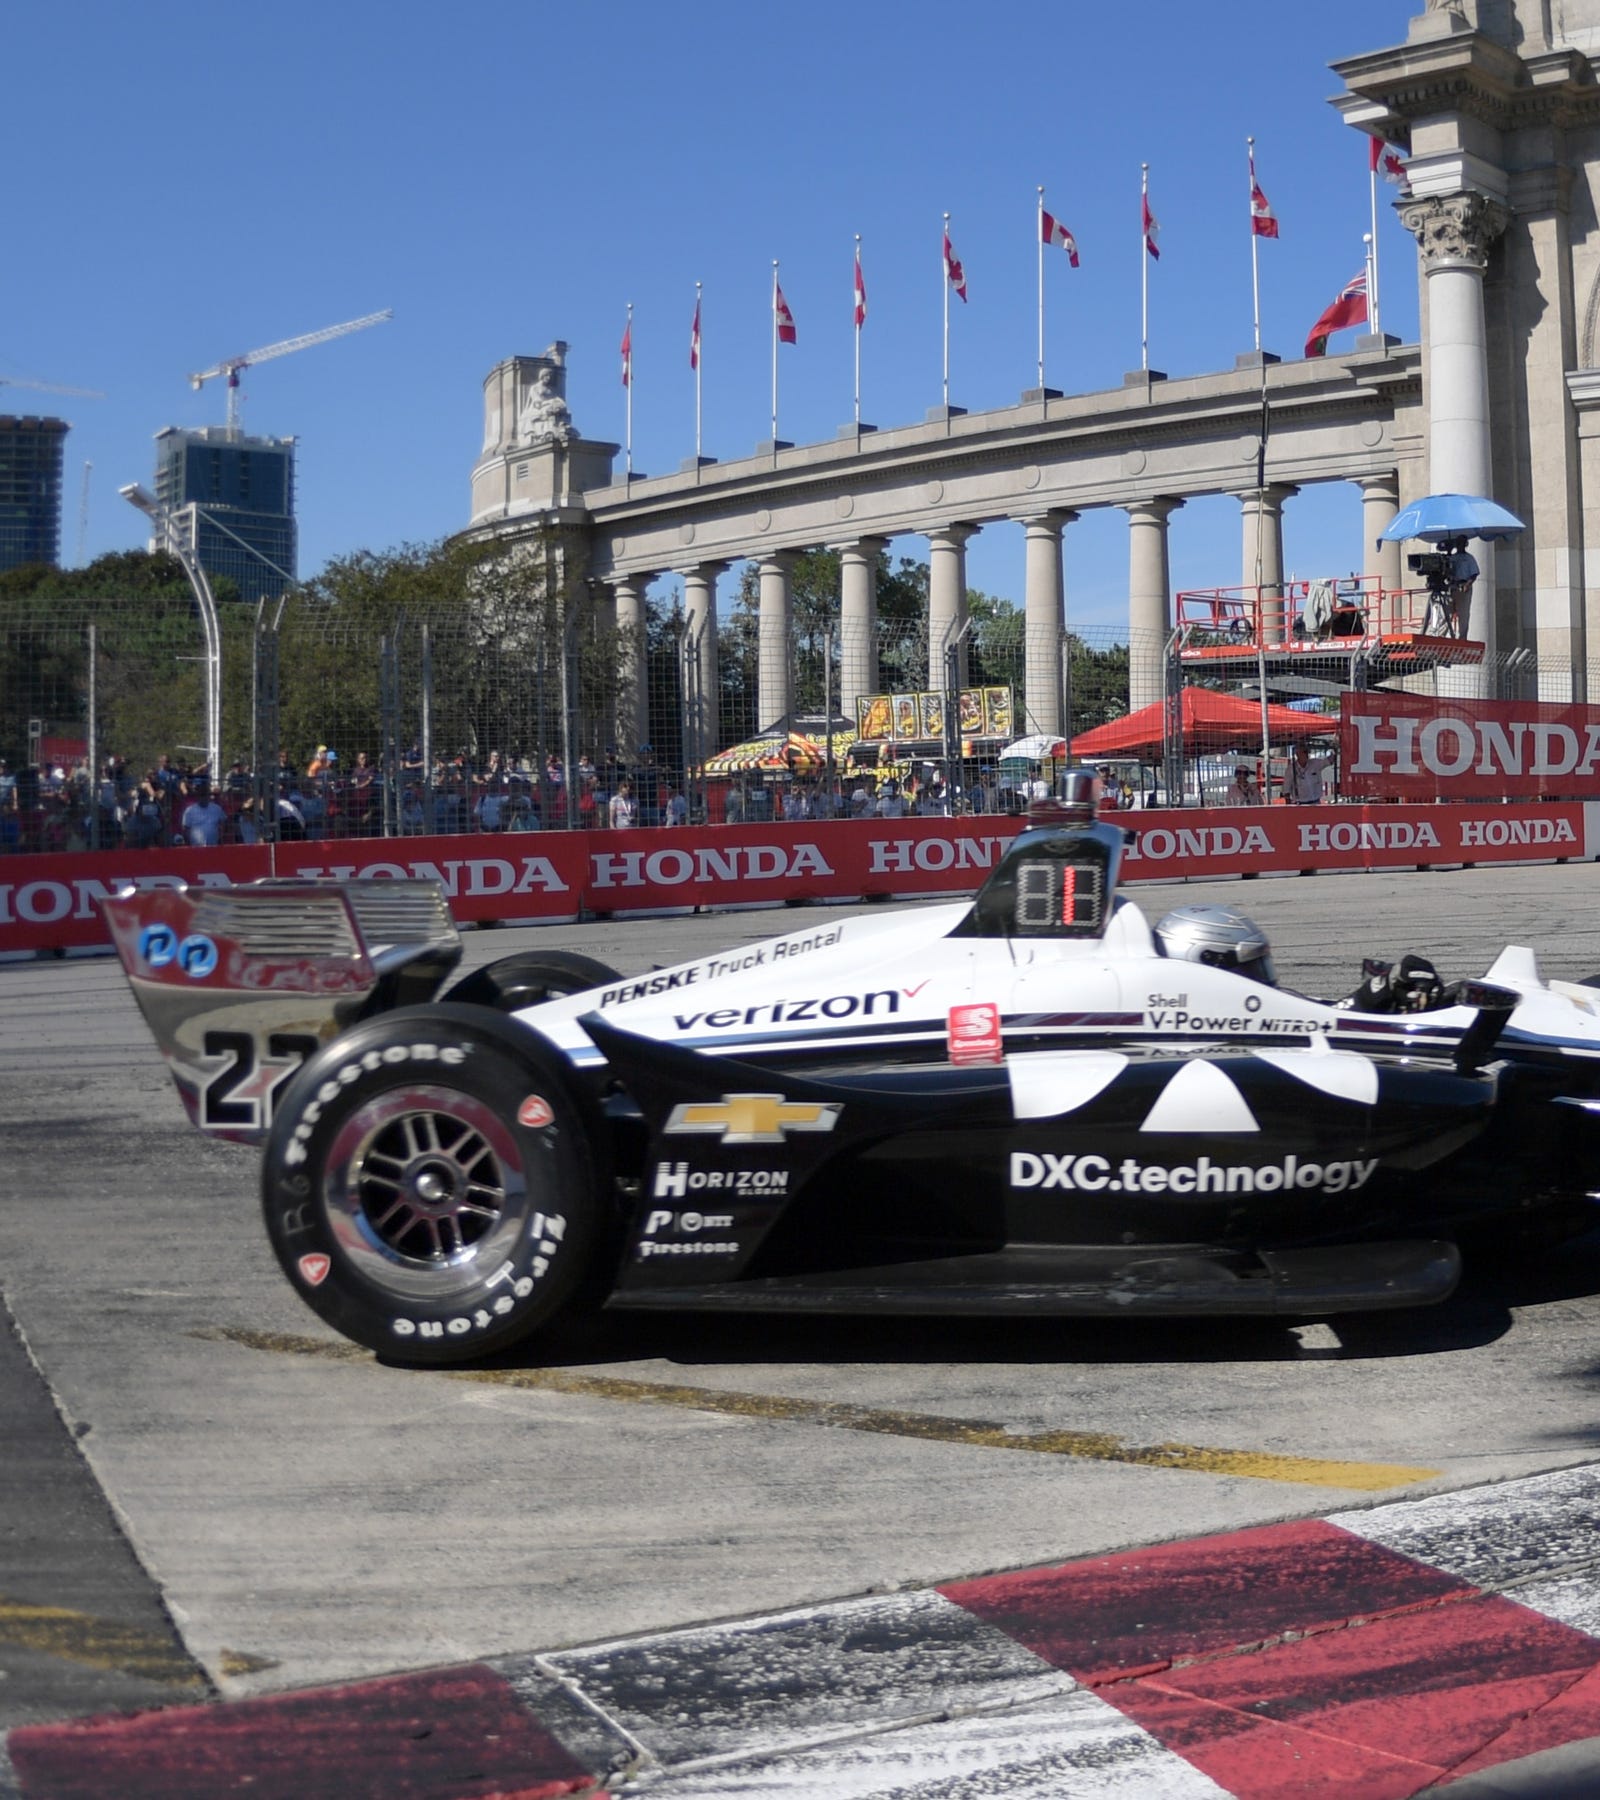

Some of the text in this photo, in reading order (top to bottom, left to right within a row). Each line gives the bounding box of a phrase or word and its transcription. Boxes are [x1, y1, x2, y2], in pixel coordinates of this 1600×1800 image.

[1298, 822, 1441, 852] HONDA
[1459, 818, 1577, 847] HONDA
[591, 843, 836, 889] HONDA
[868, 835, 1018, 874] HON
[600, 925, 845, 1009] PENSKE Truck Rental
[673, 988, 900, 1031] verizon
[1147, 994, 1188, 1008] Shell
[1149, 1011, 1254, 1031] V-Power
[653, 1161, 790, 1198] HORIZON
[1009, 1151, 1380, 1194] DXC.technology
[737, 1187, 788, 1196] GLOBAL
[639, 1241, 740, 1257] Firestone
